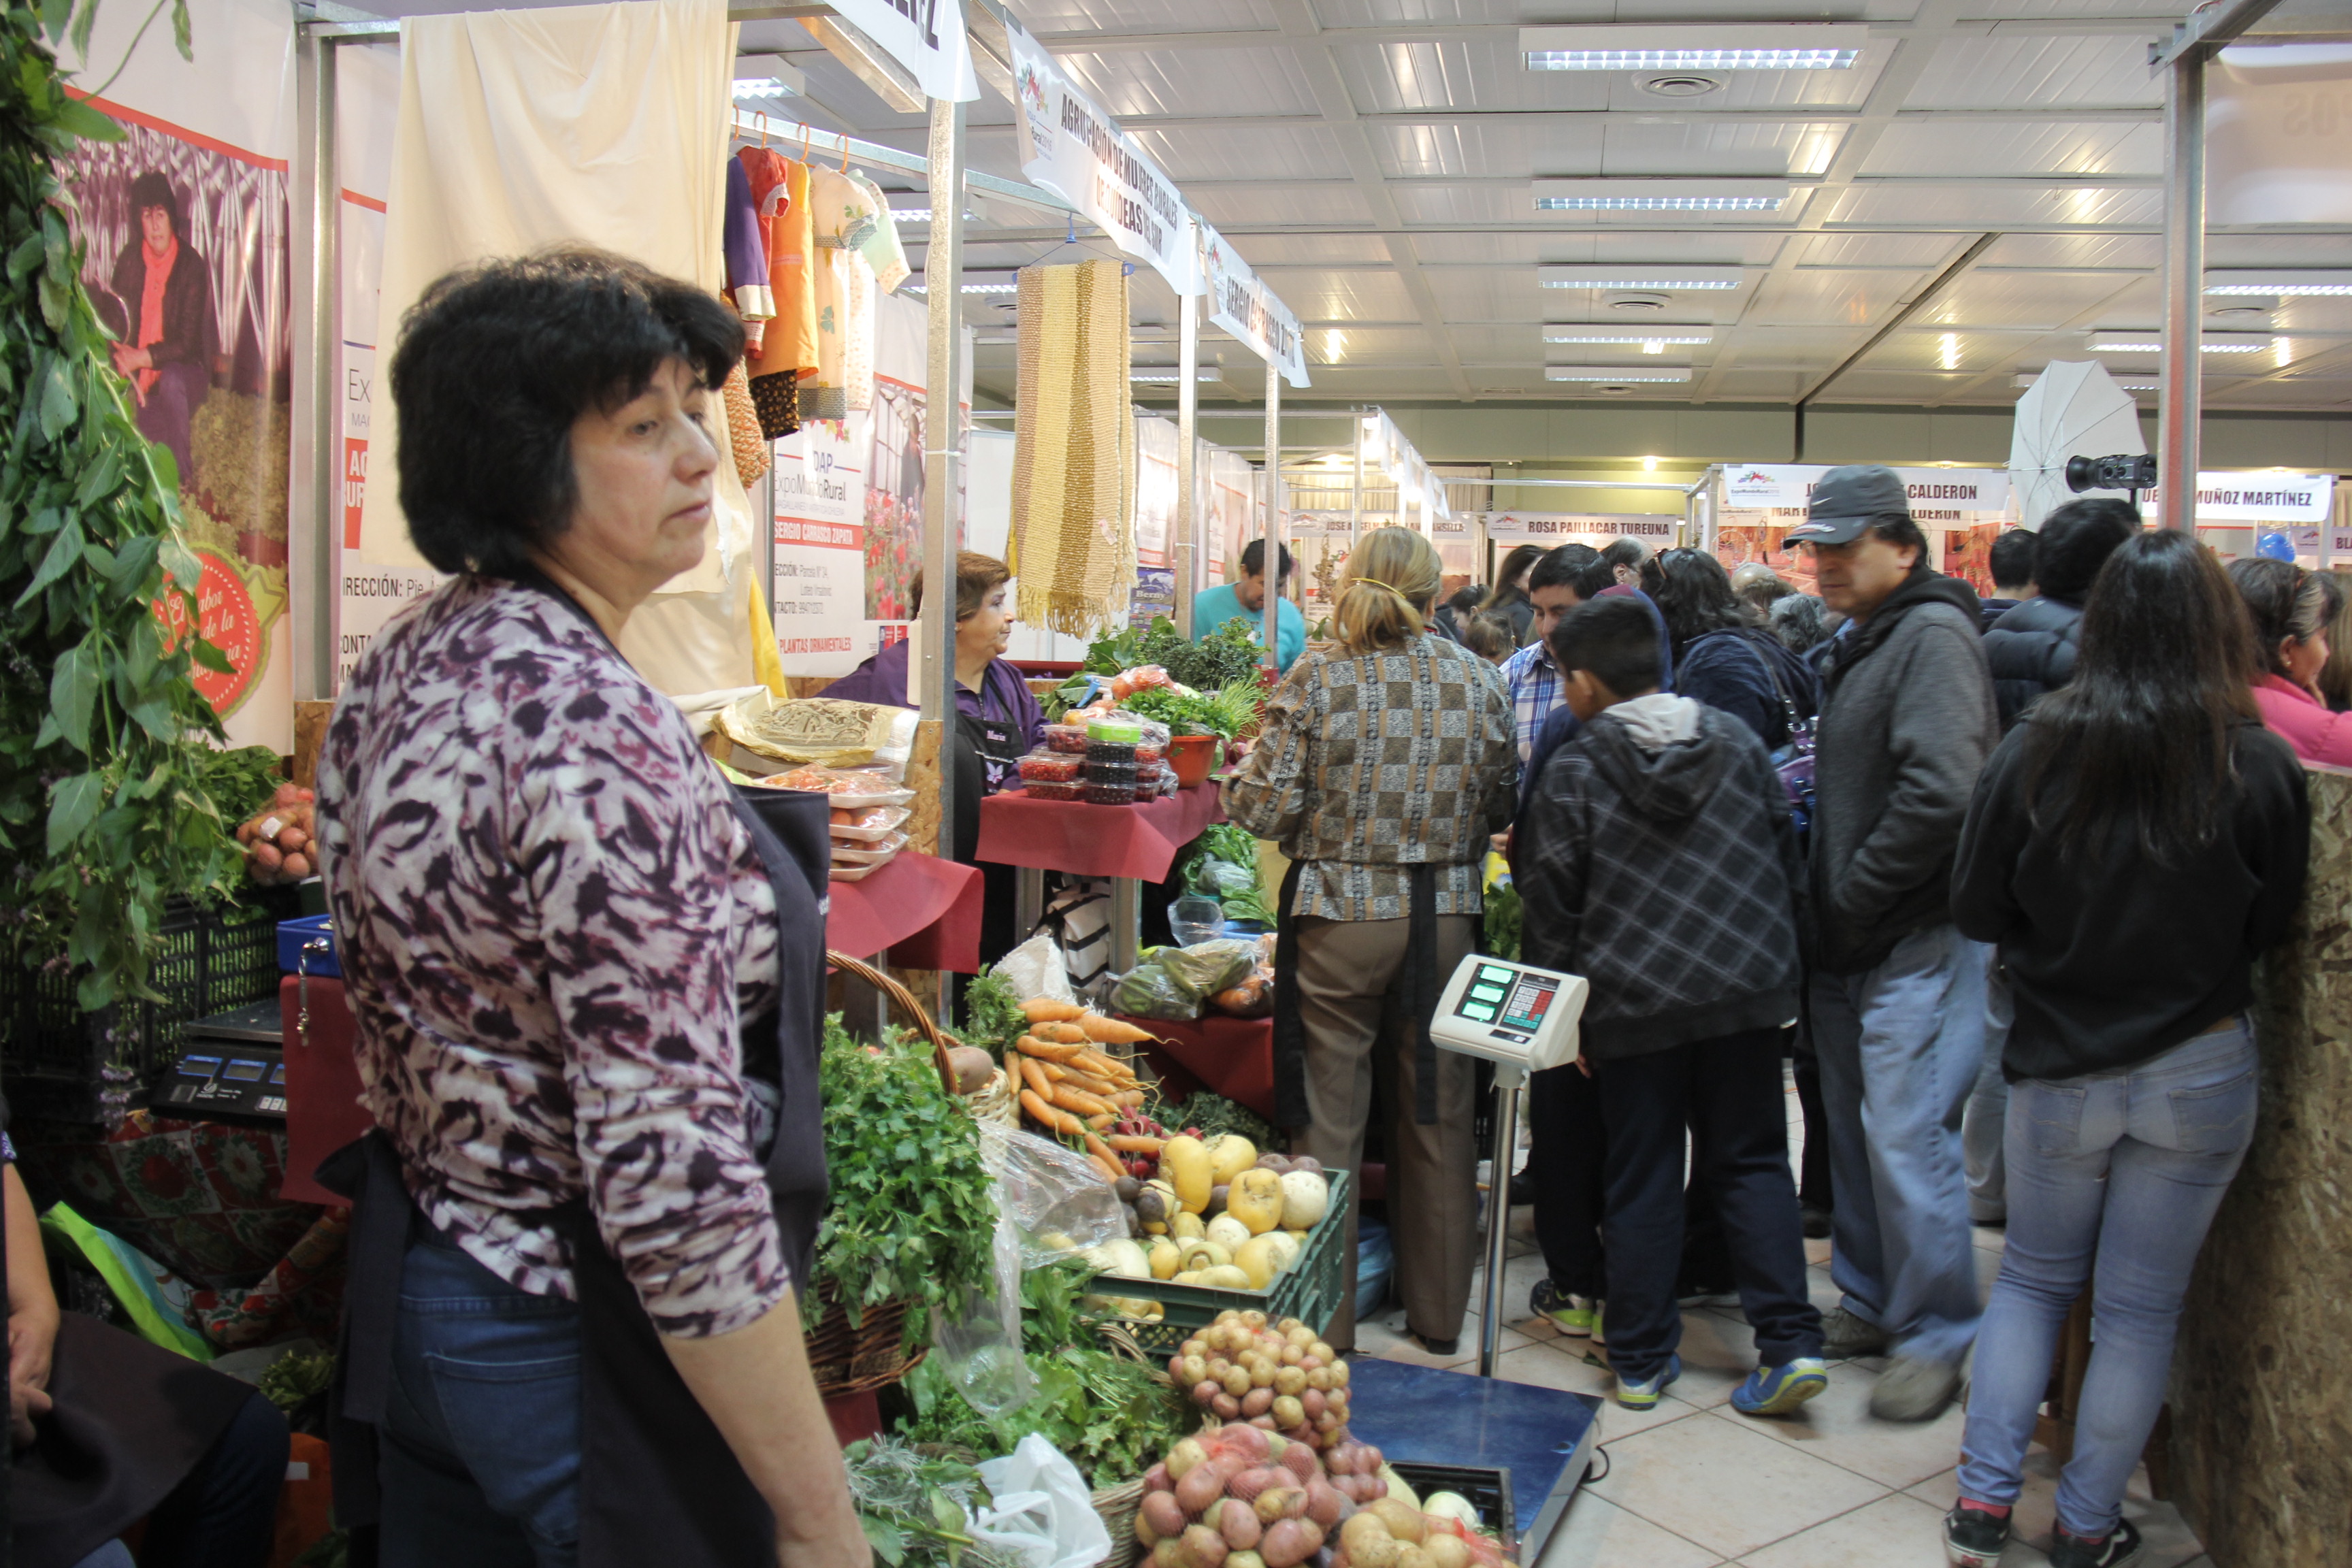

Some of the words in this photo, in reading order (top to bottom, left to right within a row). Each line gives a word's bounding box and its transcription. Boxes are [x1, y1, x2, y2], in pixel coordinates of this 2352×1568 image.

[1061, 93, 1112, 169] AGRUPACIÓN
[1113, 142, 1123, 178] DE
[1124, 152, 1154, 207] MUJERES
[1154, 182, 1177, 231] RURALES
[1096, 174, 1143, 235] ORQUÍDEAS
[1152, 220, 1162, 257] SUR
[1226, 276, 1250, 329] SERGIO
[813, 450, 833, 474] DAP
[1908, 484, 1977, 500] CALDERON
[2242, 489, 2312, 506] MARTÍNEZ
[774, 521, 801, 540] SERGIO
[802, 524, 832, 543] CARRASCO
[832, 527, 853, 545] ZAPATA
[1327, 521, 1345, 532] JOSE
[1529, 521, 1557, 534] ROSA
[1560, 522, 1617, 534] PAILLACAR
[1620, 523, 1669, 536] TUREUNA
[342, 574, 402, 598] IRECCIÓN:
[1136, 590, 1165, 600] Berny
[198, 587, 223, 613] abor
[204, 616, 216, 640] de
[220, 608, 234, 633] la
[779, 639, 808, 654] PLANTAS
[811, 637, 852, 653] ORNAMENTALES
